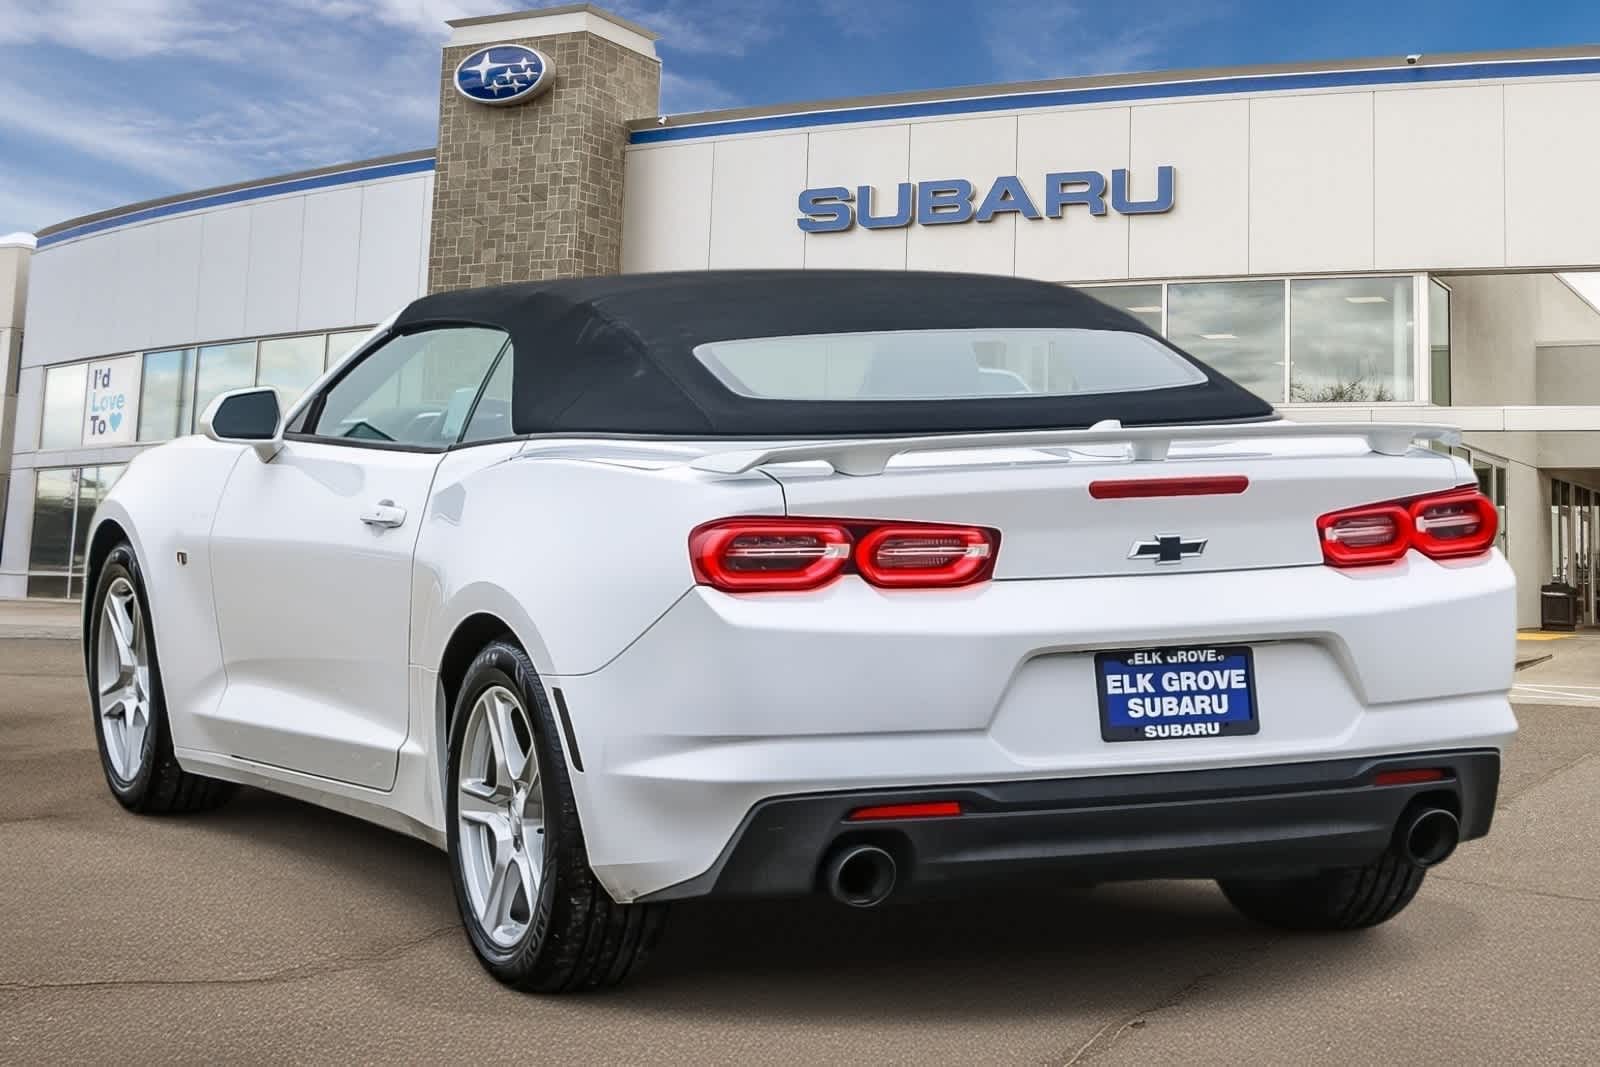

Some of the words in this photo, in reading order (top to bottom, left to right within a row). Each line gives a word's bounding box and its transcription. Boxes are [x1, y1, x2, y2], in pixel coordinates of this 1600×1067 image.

[797, 165, 1177, 233] SUBARU
[93, 367, 111, 390] I'd
[91, 391, 125, 412] Love
[90, 415, 107, 435] To
[1134, 652, 1163, 665] ELK
[1106, 673, 1156, 695] ELK
[1161, 669, 1247, 692] GROVE
[1127, 694, 1229, 719] SUBARU
[1144, 722, 1220, 738] SUBARU
